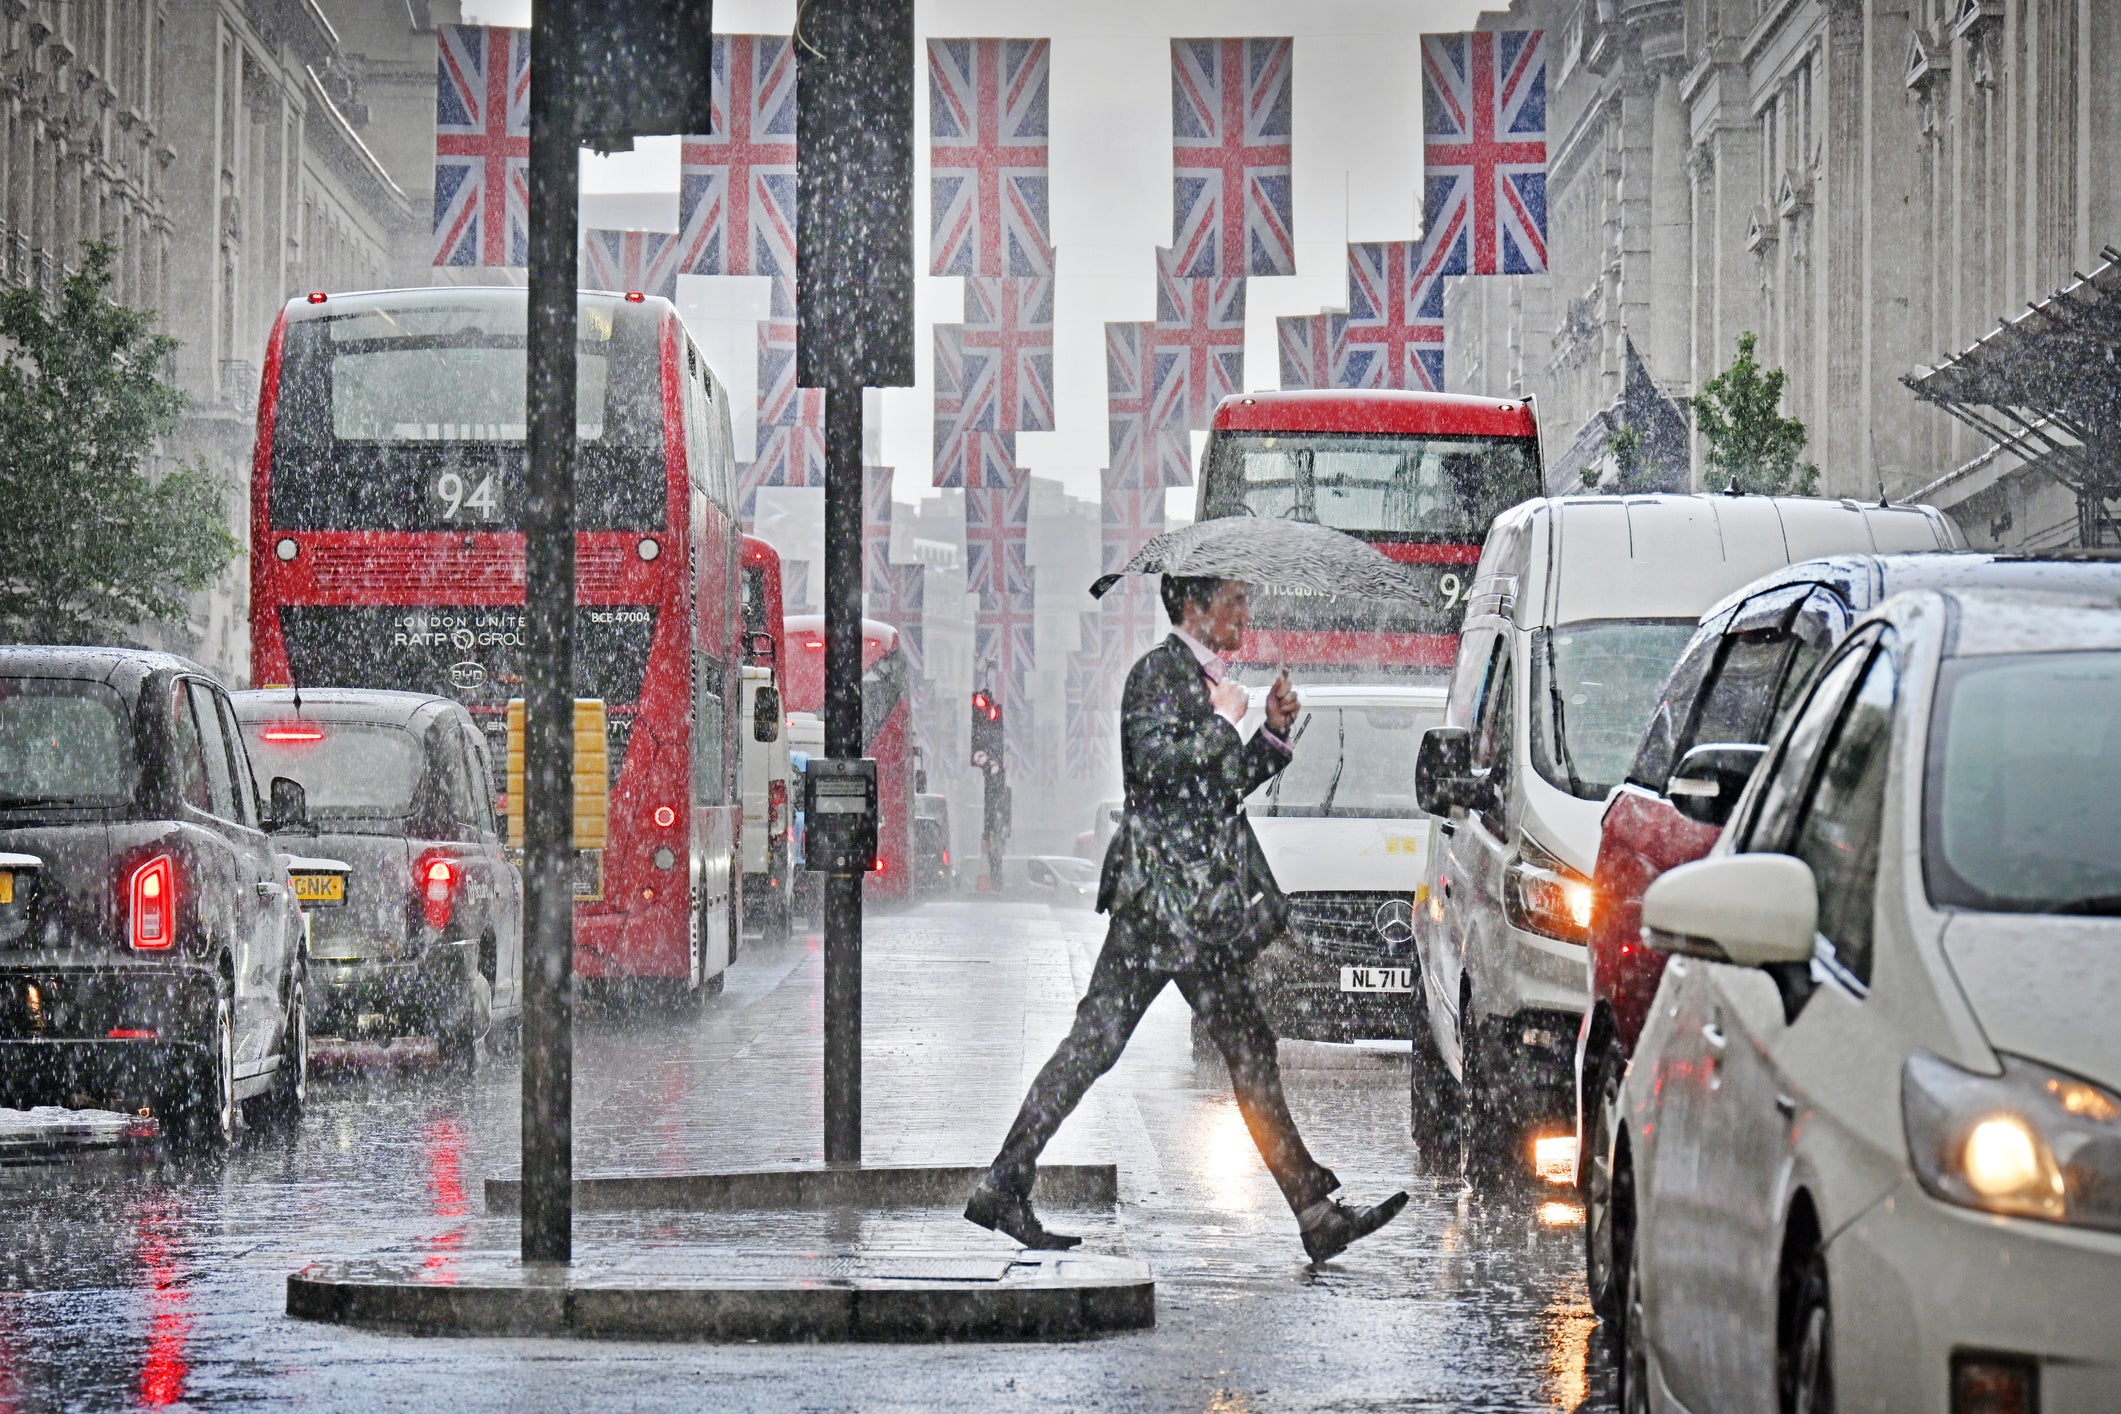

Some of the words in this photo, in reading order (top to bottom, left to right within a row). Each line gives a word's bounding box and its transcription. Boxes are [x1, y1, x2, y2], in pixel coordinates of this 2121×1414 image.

[438, 473, 496, 519] 94
[394, 616, 466, 627] LONDON
[476, 616, 525, 627] UNITE
[591, 611, 613, 622] BCE
[615, 611, 650, 622] 47004
[394, 632, 447, 646] RATP
[478, 632, 525, 646] GROU
[452, 670, 483, 681] BYD
[295, 878, 332, 895] GNK
